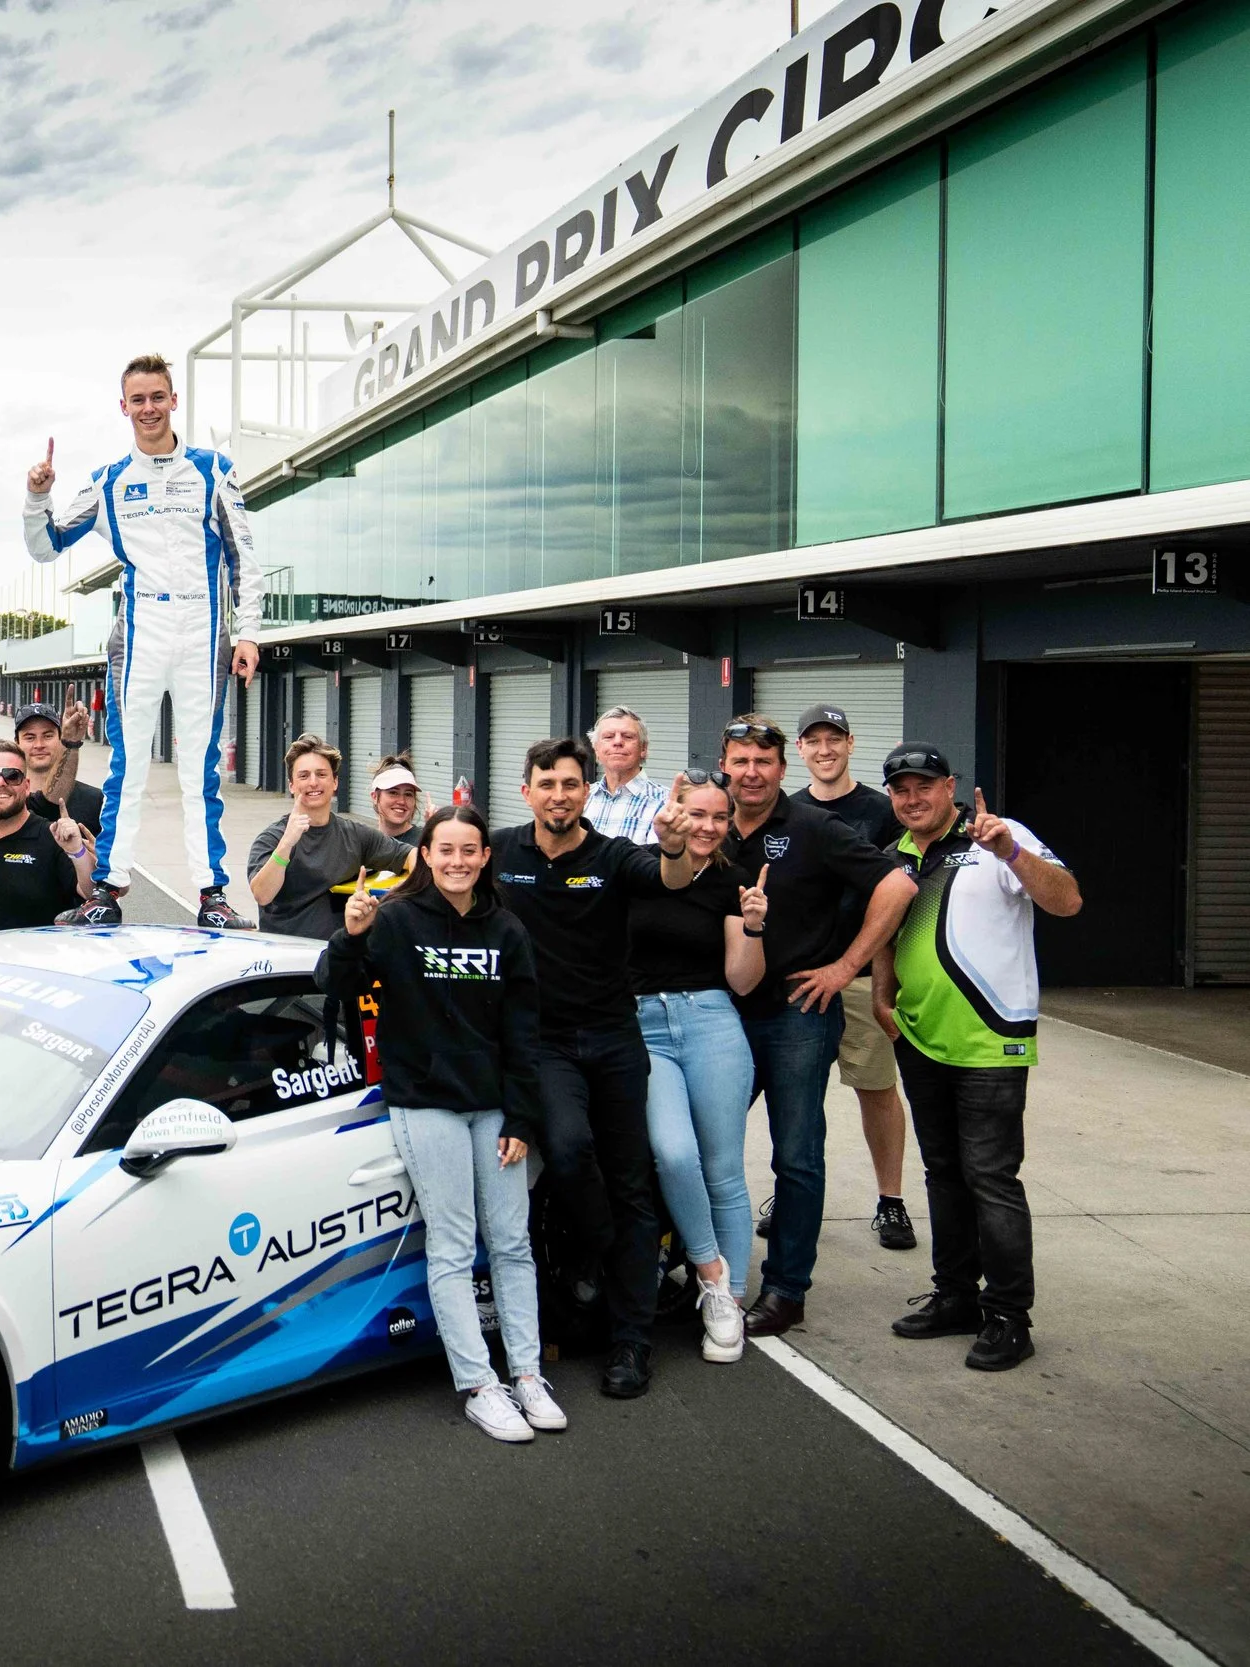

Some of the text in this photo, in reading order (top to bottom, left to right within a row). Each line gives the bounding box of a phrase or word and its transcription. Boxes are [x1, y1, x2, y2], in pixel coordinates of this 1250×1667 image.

[354, 280, 496, 407] GRAND
[515, 145, 680, 309] PRIX
[121, 507, 200, 520] TEGRA AUSTRALIA
[1160, 552, 1209, 585] 13
[803, 590, 839, 614] 14
[603, 611, 631, 631] 15
[324, 641, 342, 653] 18
[388, 634, 409, 648] 17
[895, 641, 905, 659] 15
[274, 646, 290, 657] 19
[21, 1021, 94, 1062] Sargent
[70, 1018, 157, 1136] @PorscheMotorsportAU
[271, 1054, 363, 1100] Sargent
[141, 1111, 222, 1129] Greenfield
[142, 1125, 224, 1140] Town Planning
[58, 1255, 237, 1340] TEGRA
[63, 1409, 104, 1431] AMADIO
[68, 1420, 100, 1437] WINES
